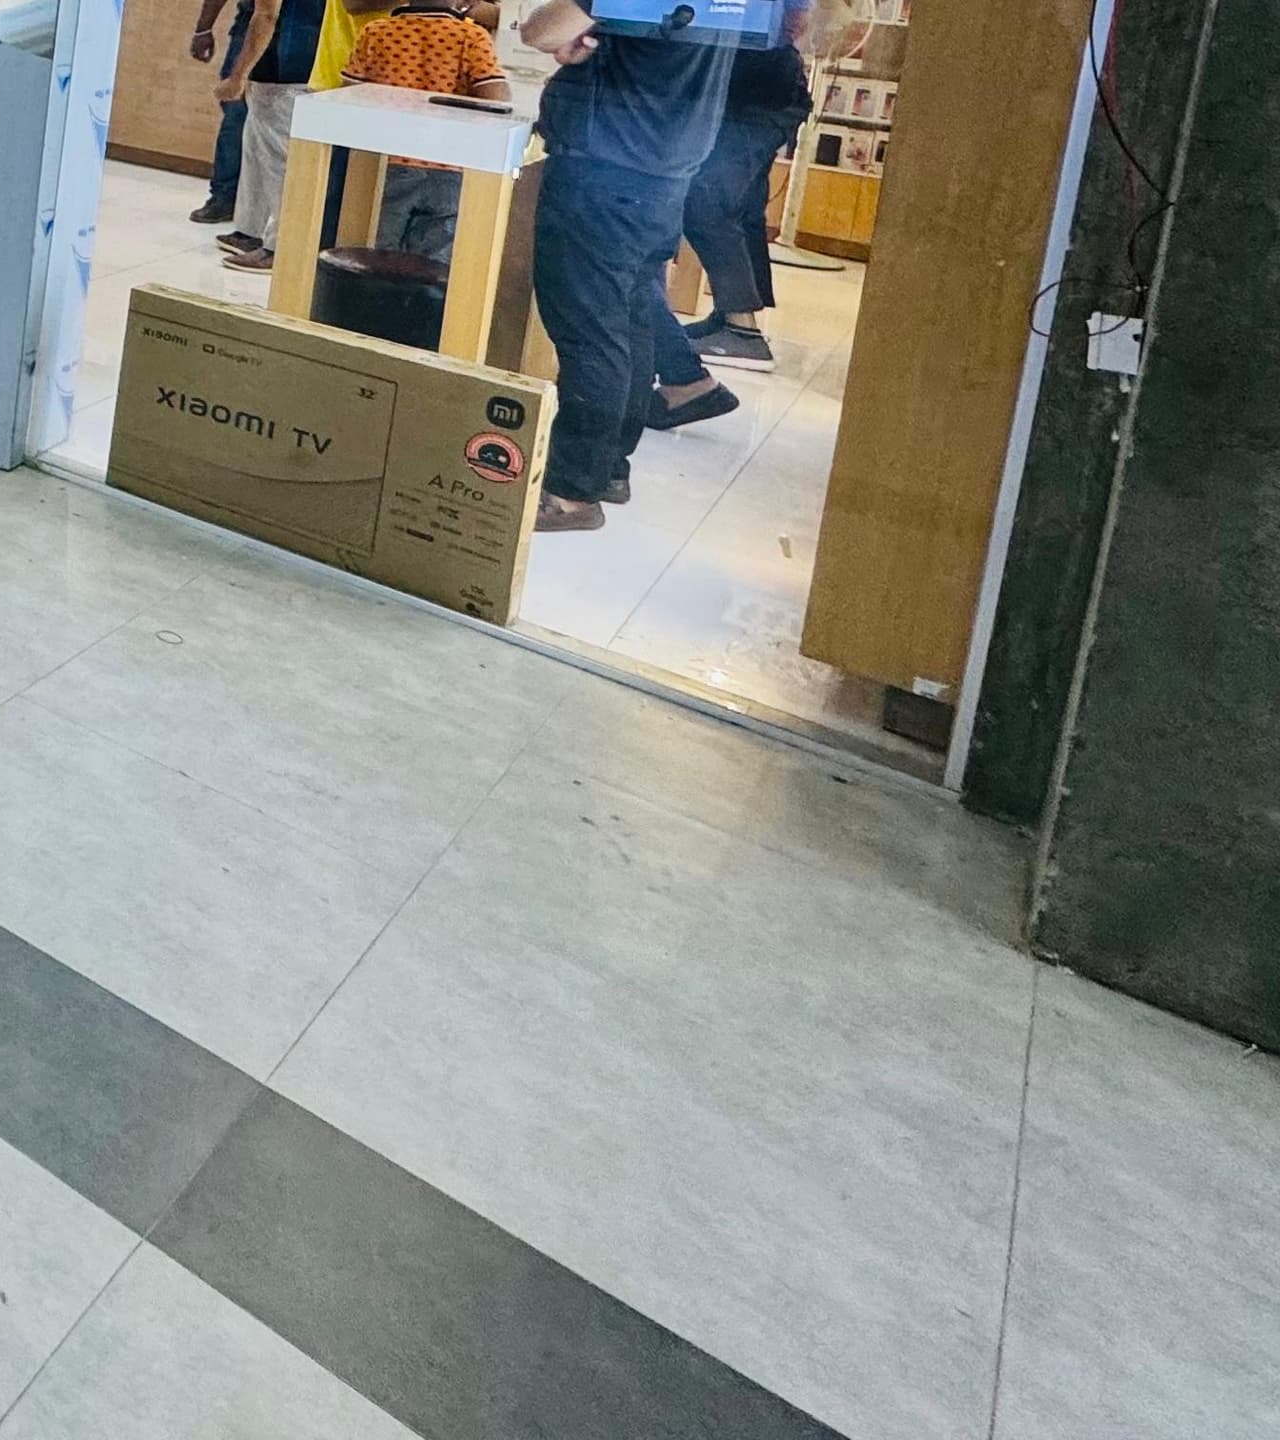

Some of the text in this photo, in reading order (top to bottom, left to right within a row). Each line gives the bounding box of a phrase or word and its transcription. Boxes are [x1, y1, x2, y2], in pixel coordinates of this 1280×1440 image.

[292, 427, 333, 455] TV
[427, 474, 485, 502] A Pro
